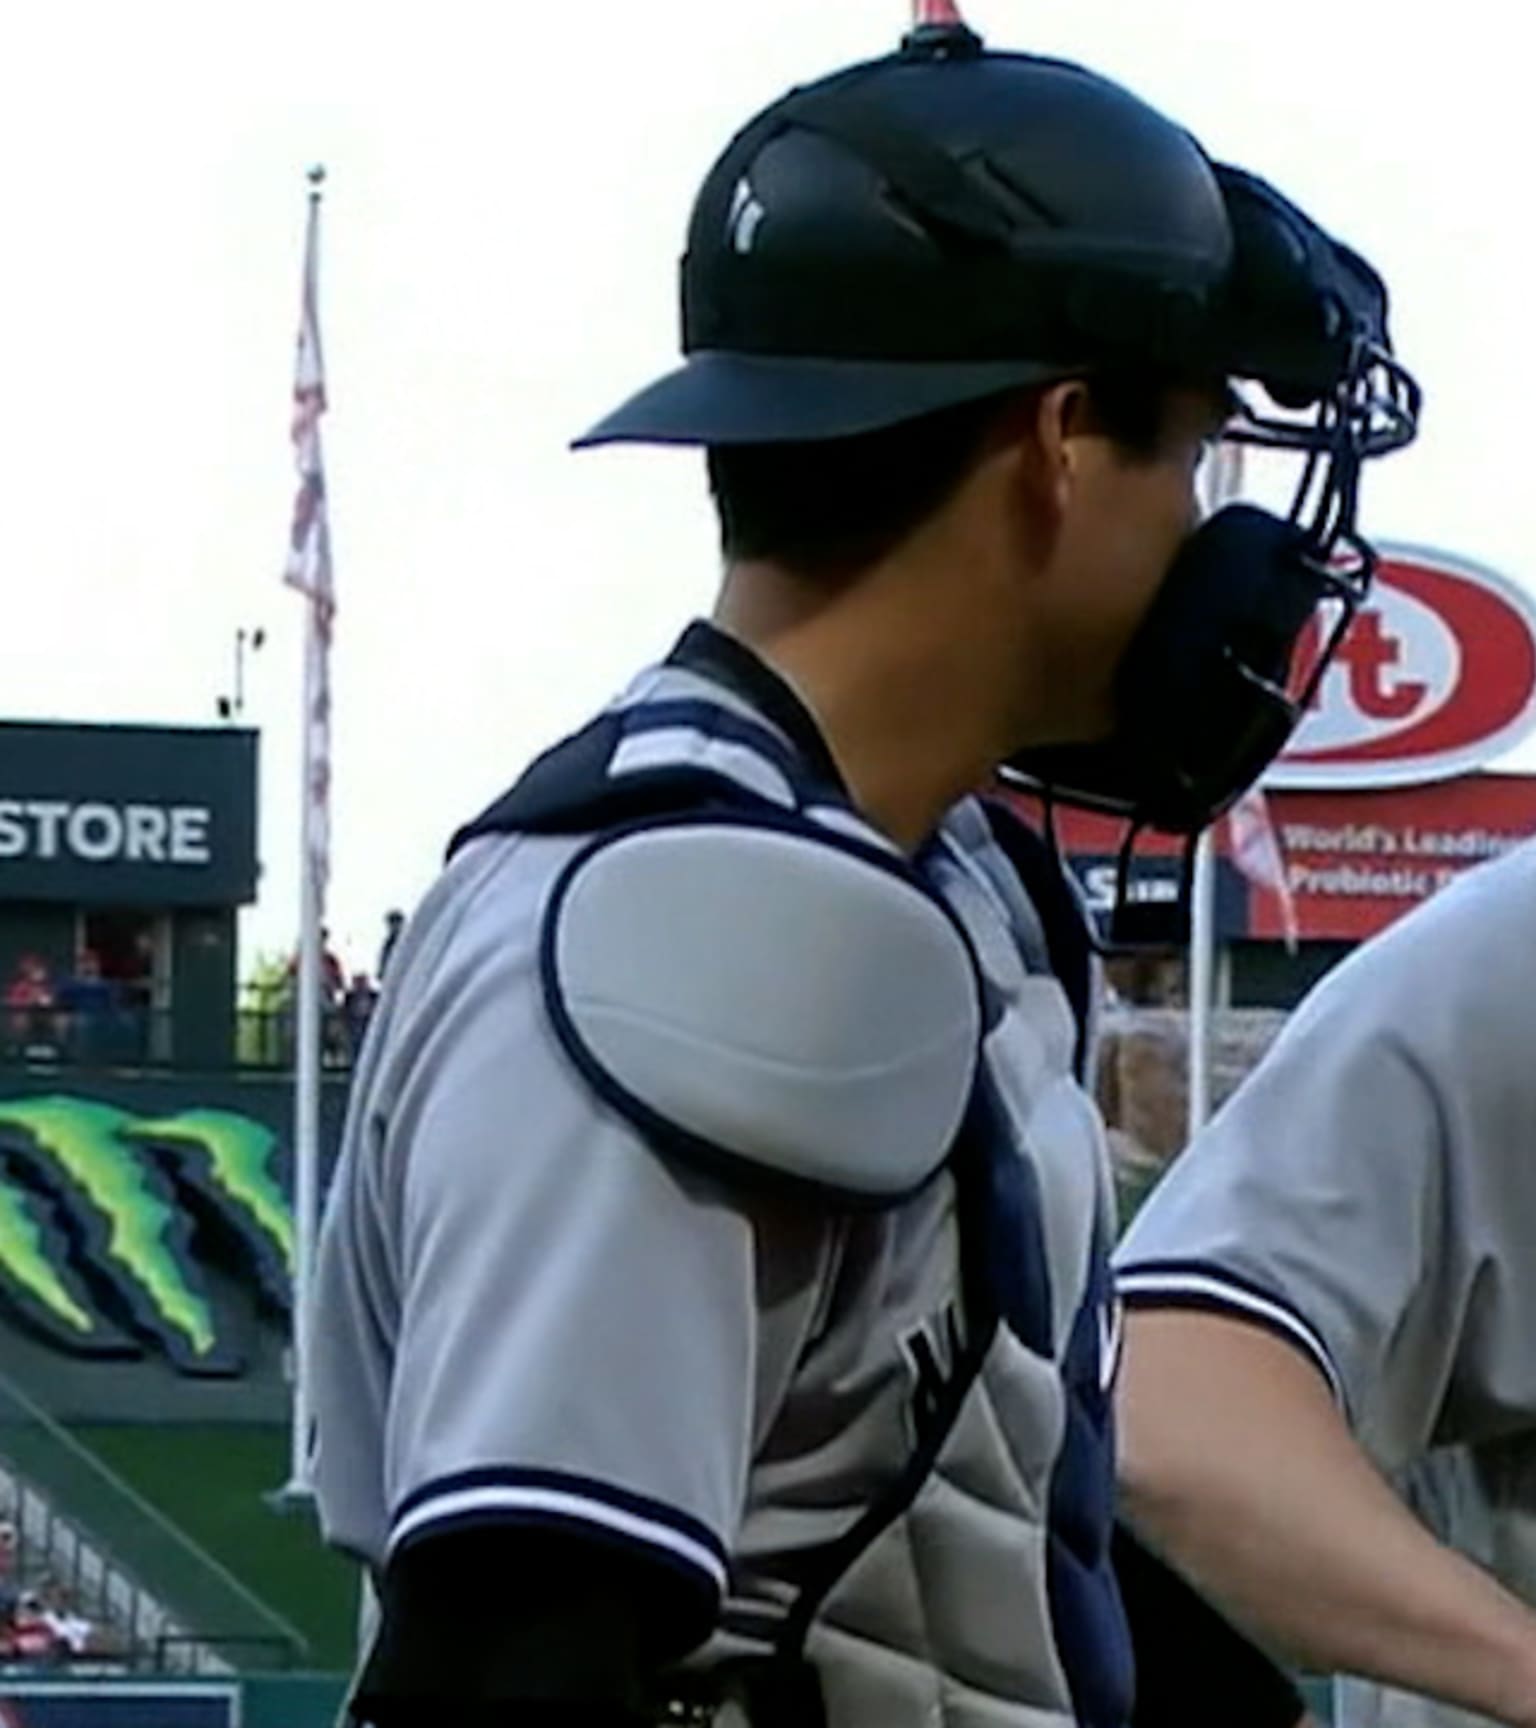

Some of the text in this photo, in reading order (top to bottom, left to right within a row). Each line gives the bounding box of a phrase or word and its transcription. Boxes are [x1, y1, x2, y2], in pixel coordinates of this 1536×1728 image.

[0, 801, 210, 862] STORE
[1283, 823, 1397, 853] World's
[1287, 862, 1427, 897] Probiotic
